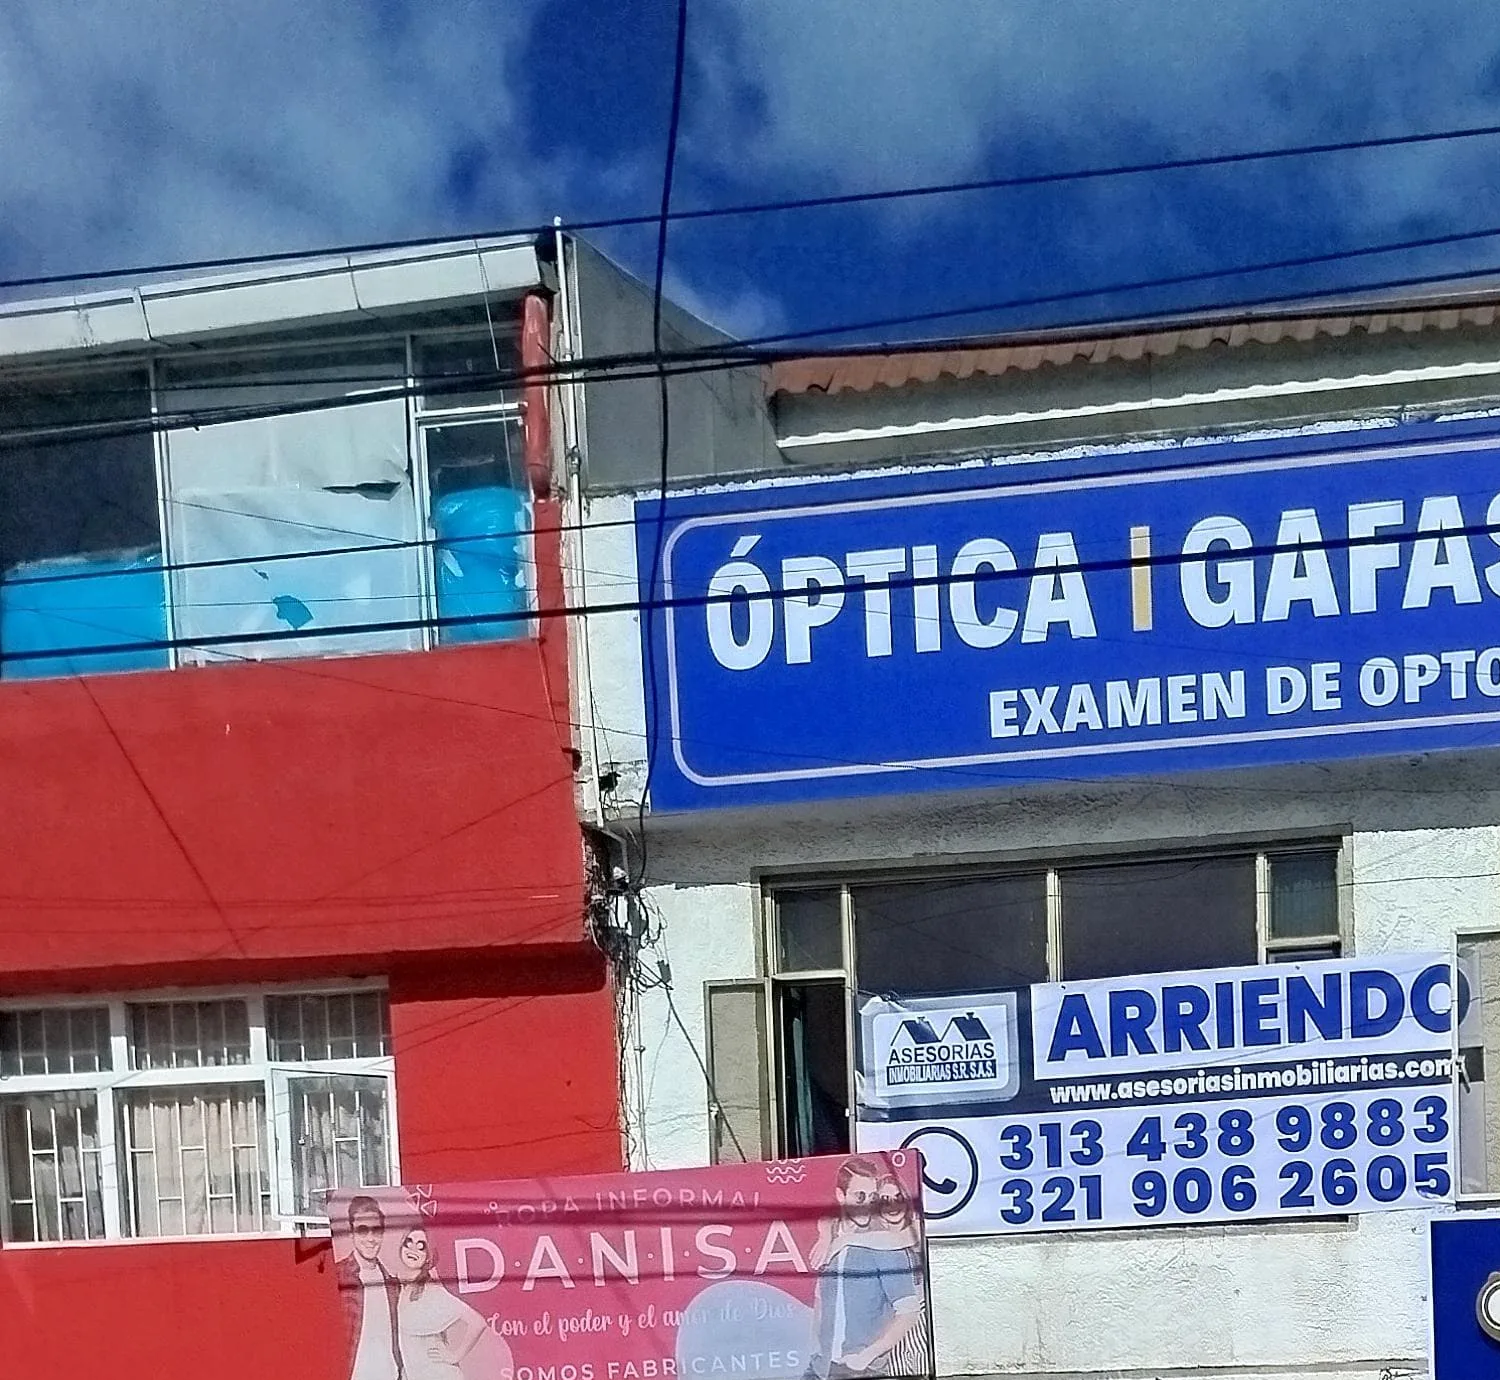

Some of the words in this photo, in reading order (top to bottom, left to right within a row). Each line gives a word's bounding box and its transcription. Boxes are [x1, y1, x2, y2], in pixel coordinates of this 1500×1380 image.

[705, 533, 1097, 673] ÓPTICA
[989, 674, 1249, 741] EXAMEN
[1266, 662, 1342, 716] DE
[1047, 963, 1470, 1063] ARRIENDO
[888, 1042, 995, 1065] ASESORIAS
[888, 1064, 952, 1084] INMOBILIARIAS
[969, 1060, 995, 1077] S.A.S.
[1000, 1120, 1104, 1170] 313
[1127, 1109, 1255, 1162] 438
[1277, 1095, 1450, 1152] 9883
[1000, 1174, 1102, 1225] 321
[1131, 1164, 1258, 1218] 906
[1279, 1151, 1451, 1208] 2605
[533, 1312, 553, 1336] el
[557, 1308, 613, 1342] poder
[618, 1316, 633, 1337] y
[638, 1303, 657, 1329] el
[607, 1350, 801, 1380] FABRICANTES
